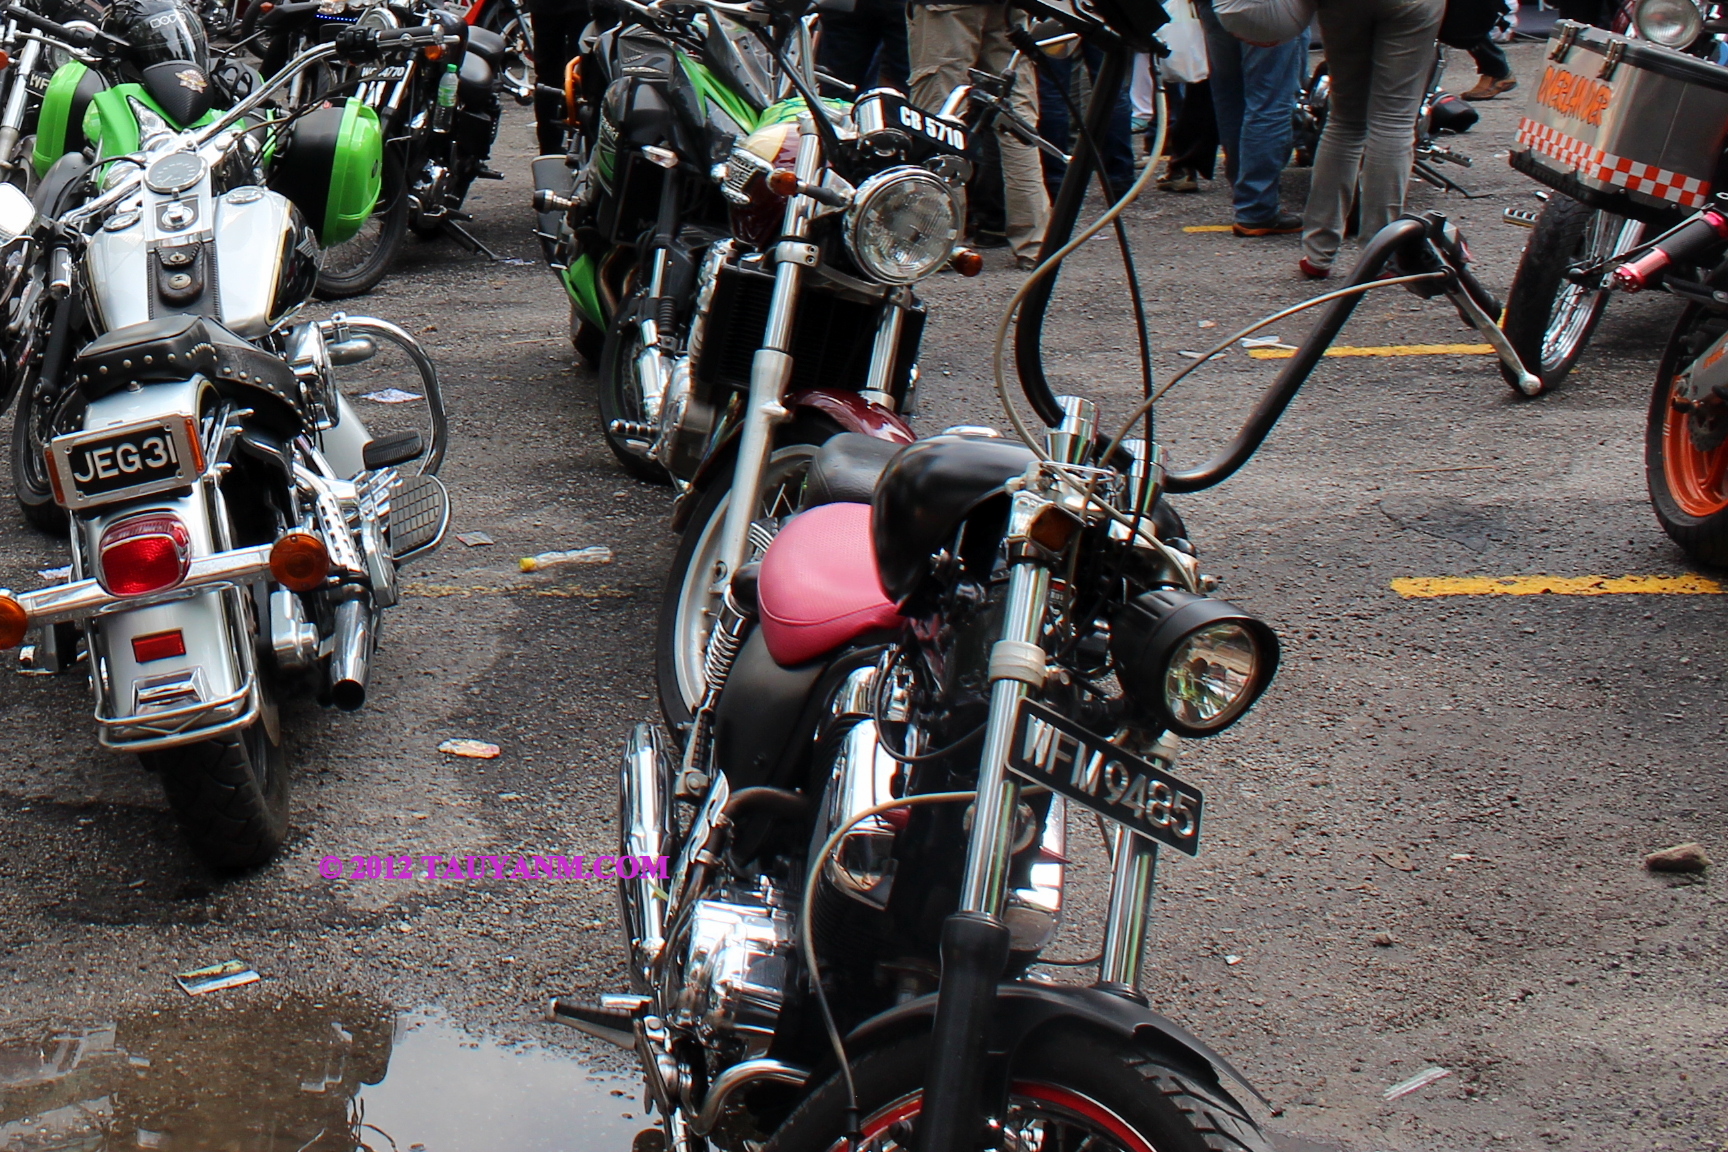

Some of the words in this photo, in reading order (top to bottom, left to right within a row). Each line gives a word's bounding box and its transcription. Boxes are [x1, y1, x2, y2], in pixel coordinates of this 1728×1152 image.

[1537, 65, 1613, 128] OVERLANDER
[899, 105, 922, 131] CB
[925, 116, 965, 151] 5710
